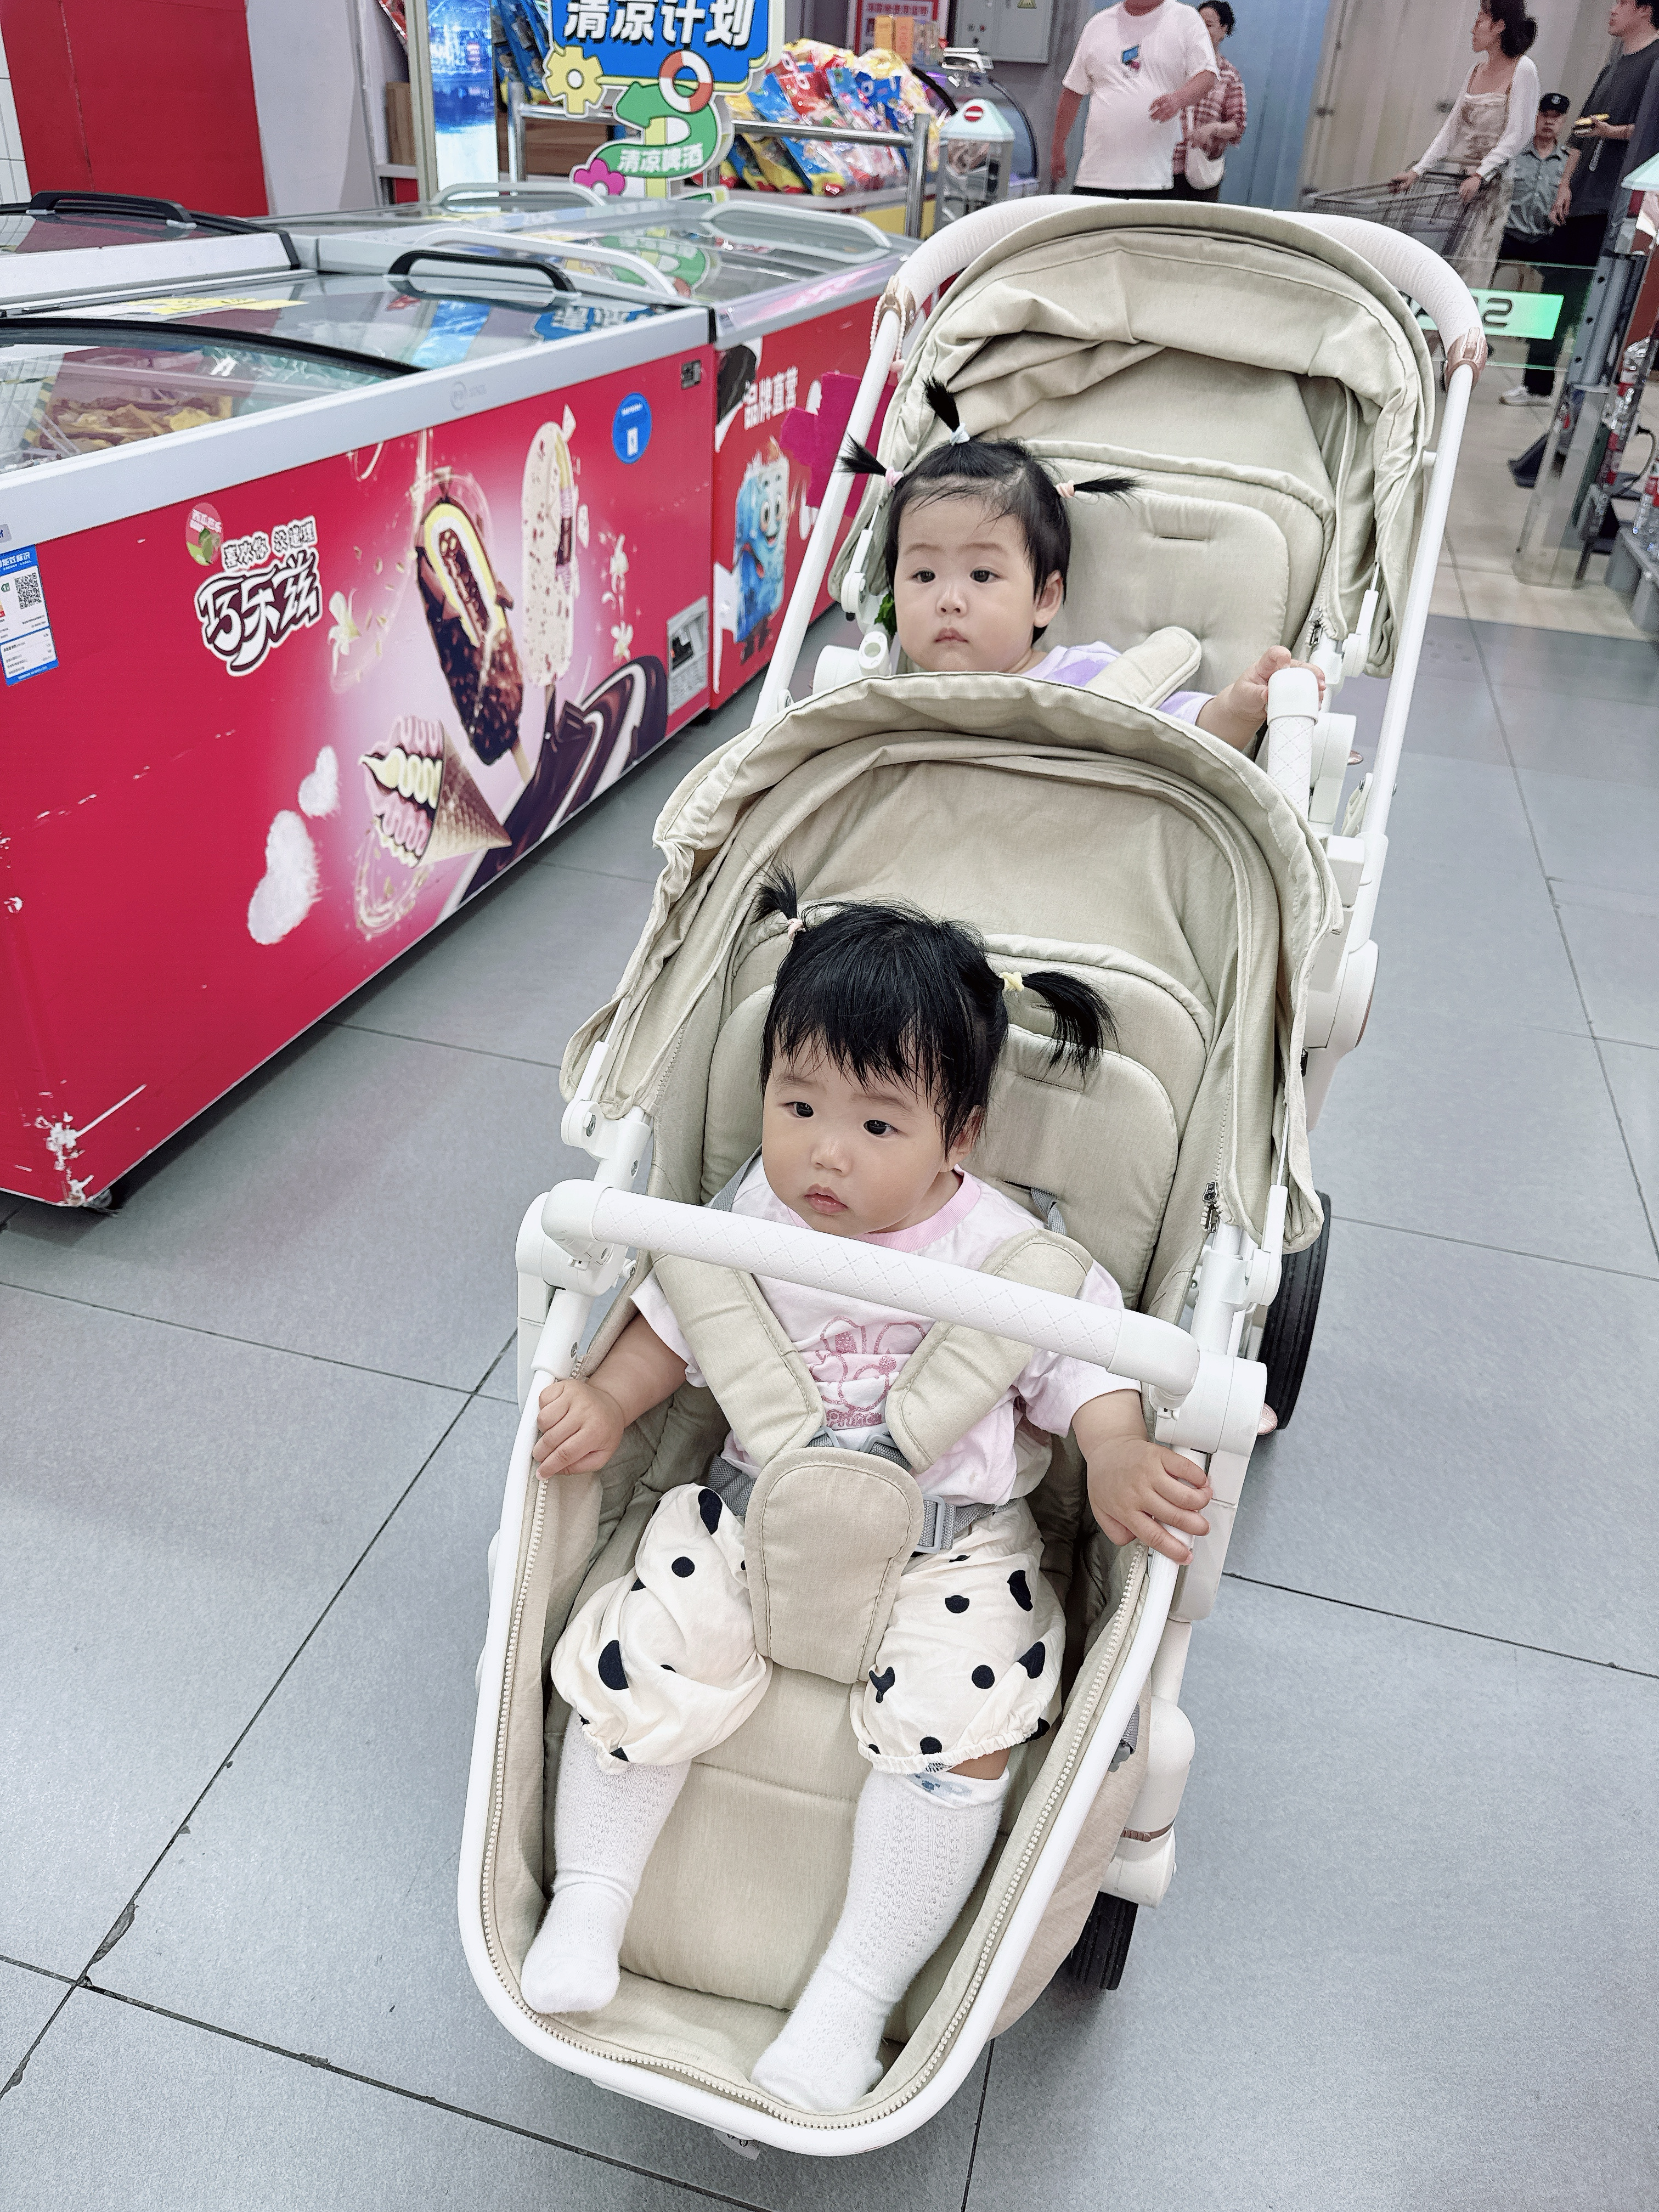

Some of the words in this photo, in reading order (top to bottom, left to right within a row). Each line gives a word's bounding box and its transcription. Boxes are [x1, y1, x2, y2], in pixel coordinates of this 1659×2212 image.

[563, 0, 755, 46] 清凉计划
[198, 549, 320, 672] 巧乐兹
